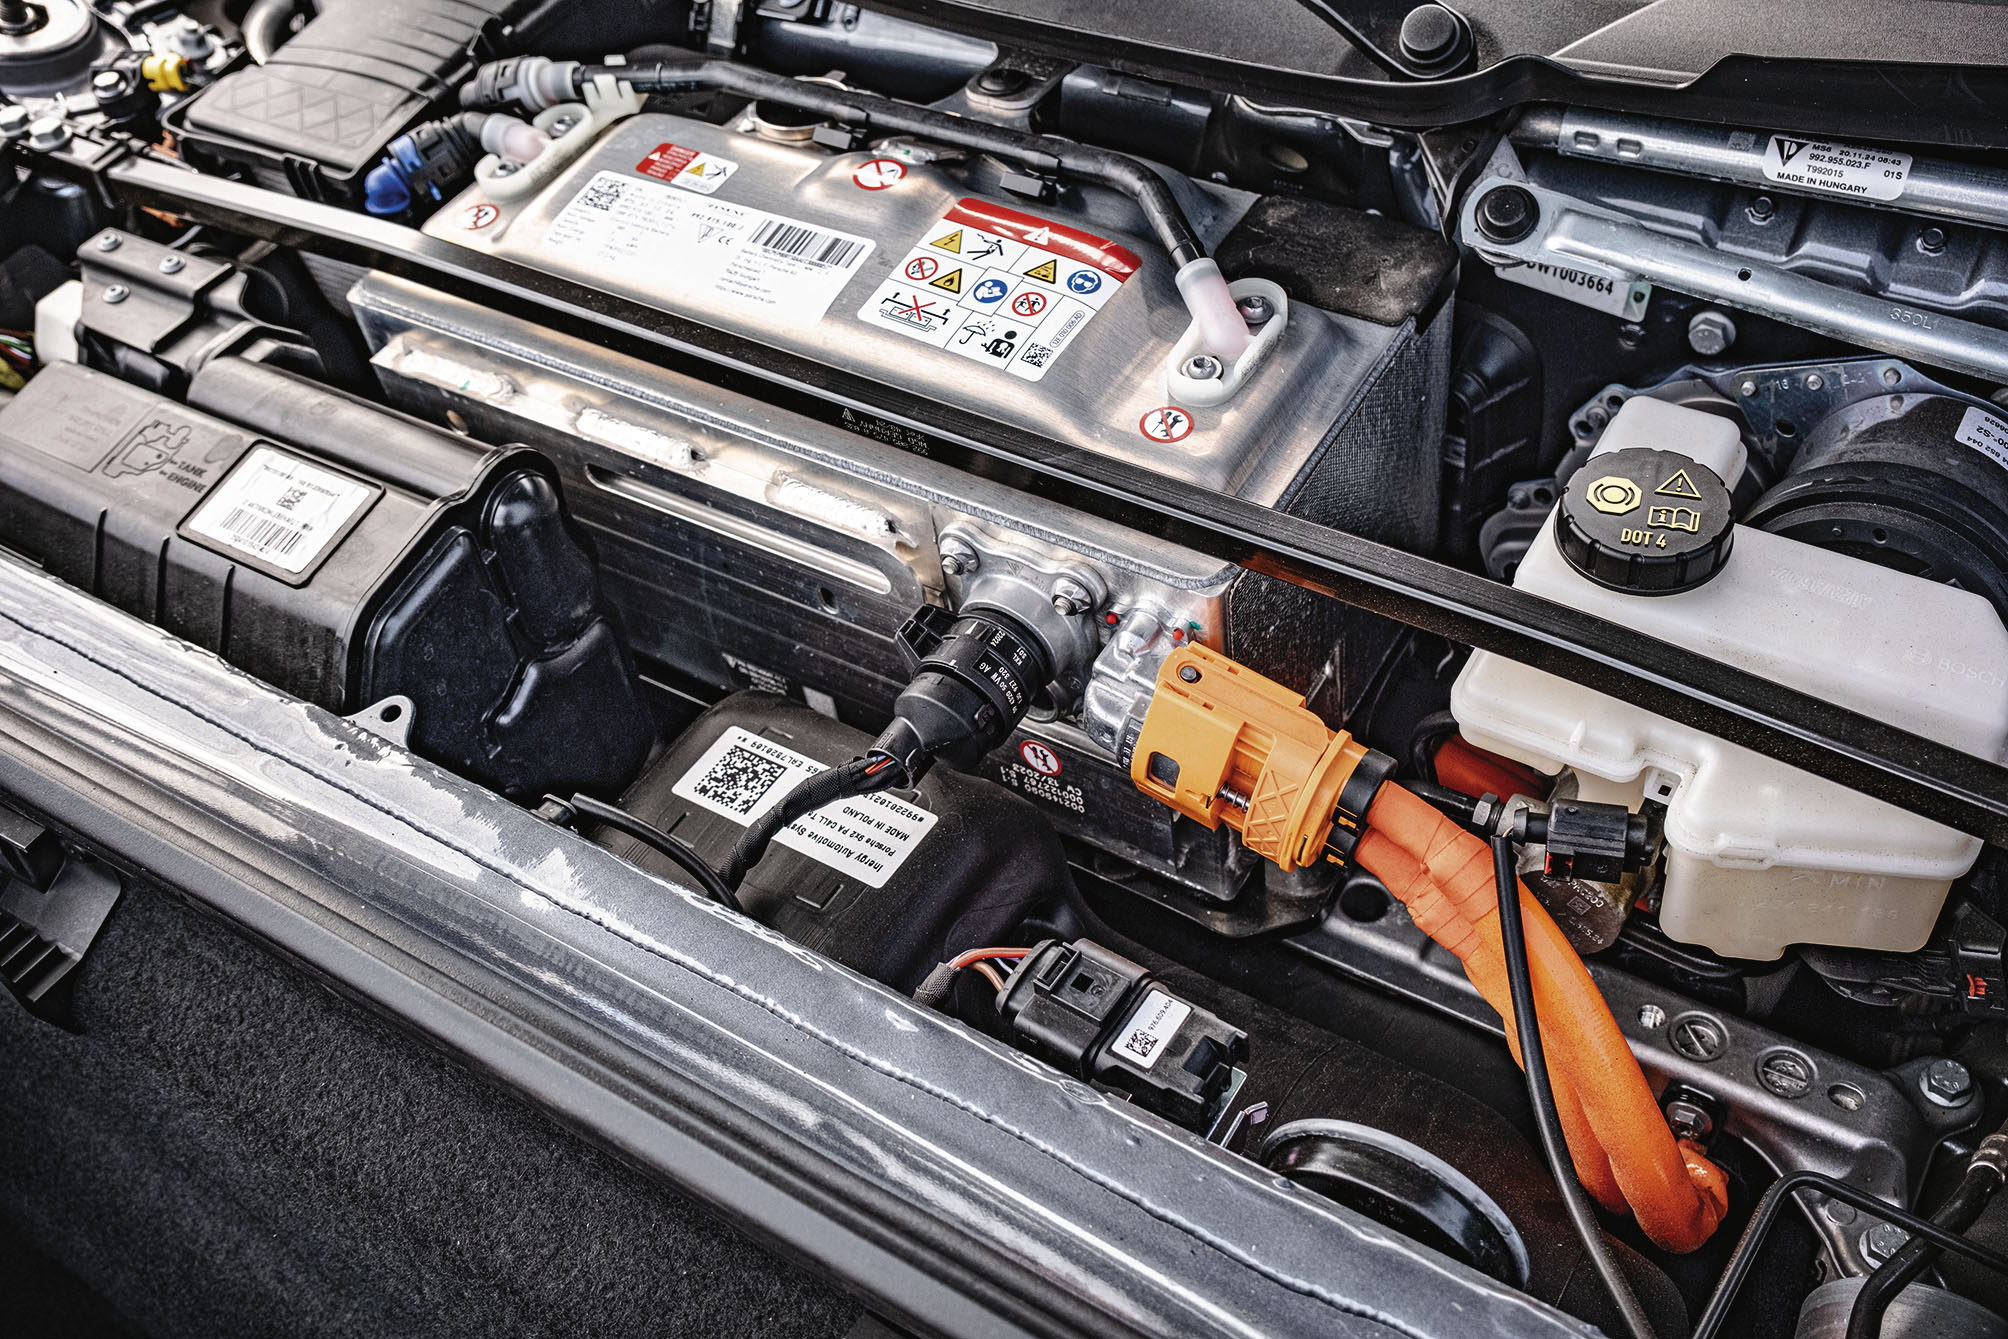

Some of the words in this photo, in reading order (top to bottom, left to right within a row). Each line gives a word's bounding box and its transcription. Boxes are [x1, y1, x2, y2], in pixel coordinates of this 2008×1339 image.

[1809, 153, 1871, 169] 992.955.023.F
[1812, 144, 1832, 152] MS6
[1839, 150, 1875, 161] 20.11.24
[1877, 156, 1901, 166] 08:43
[1806, 164, 1844, 178] T992015
[1883, 170, 1902, 180] 01S
[1776, 172, 1804, 183] MADE
[1806, 176, 1816, 186] IN
[1818, 179, 1868, 194] HUNGARY
[177, 459, 208, 479] TANK
[166, 472, 208, 494] ENGINE
[1620, 528, 1654, 546] DOT
[1656, 534, 1667, 548] 4
[979, 662, 992, 673] AG
[1937, 656, 2007, 688] BOSCH
[1012, 763, 1060, 787] 13/2023
[1066, 784, 1082, 796] CW
[842, 806, 875, 826] POLAND
[874, 820, 886, 831] IN
[838, 824, 850, 836] PA
[850, 830, 866, 842] 9x2
[885, 826, 910, 842] MADE
[808, 831, 856, 858] Automotive
[865, 838, 896, 857] Porsche
[854, 852, 884, 872] Inergy
[1829, 874, 1886, 890] MIN
[1148, 998, 1174, 1031] 976.609.404
